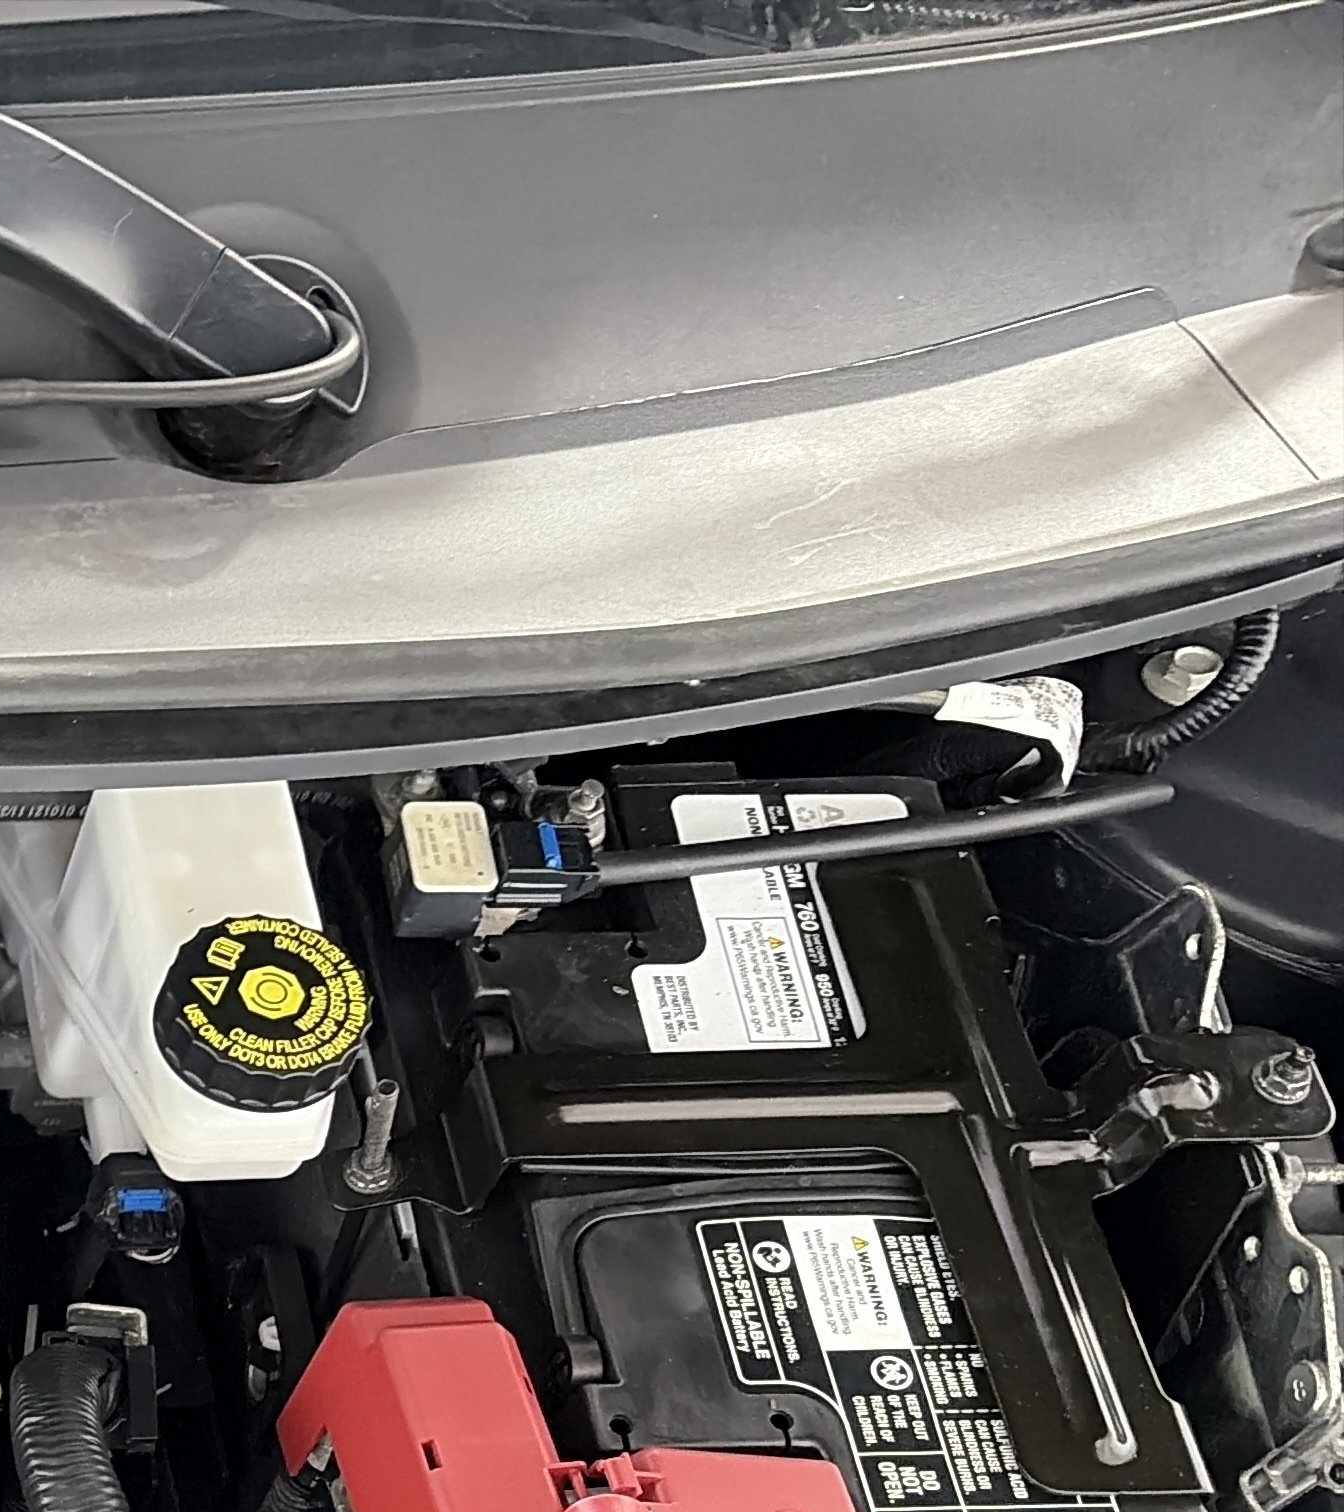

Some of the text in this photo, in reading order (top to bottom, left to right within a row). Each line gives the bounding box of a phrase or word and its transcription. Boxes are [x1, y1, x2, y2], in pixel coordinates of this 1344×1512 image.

[793, 901, 821, 931] 760
[183, 919, 367, 1069] USE ONLY DOT3 OR DOT4 BRAKE FLUID FROM A SEALED CONTAINER
[229, 935, 347, 1053] CLEAN FILLER CAP BEFORE REMOVING
[663, 975, 677, 992] BEST
[675, 975, 700, 1031] DISTRIBUTED BY
[761, 965, 787, 1012] Reproductive
[771, 951, 806, 1022] WARNING:
[813, 973, 835, 997] 950
[293, 985, 327, 1032] WARNING
[811, 1228, 828, 1251] Wash
[882, 1235, 910, 1285] OR INJURY.
[819, 1253, 836, 1277] hands
[827, 1242, 854, 1294] Reproductive
[827, 1279, 842, 1297] after
[844, 1258, 868, 1305] Cancer and
[854, 1251, 891, 1326] WARNING:
[896, 1235, 941, 1337] CAN CAUSE BLINDNESS
[910, 1234, 953, 1324] EXPLOSIVE GASES
[710, 1249, 753, 1352] Lead Acid Battery
[719, 1241, 775, 1360] NON-SPILLABLE
[776, 1277, 799, 1309] READ
[761, 1277, 802, 1364] INSTRUCTIONS.
[922, 1360, 950, 1404] SMOKING
[938, 1360, 963, 1397] FLAMES
[954, 1360, 978, 1397] SPARKS
[849, 1395, 880, 1447] CHILDREN.
[867, 1394, 896, 1443] REACH OF
[884, 1394, 909, 1428] OF THE
[902, 1394, 930, 1440] KEEP OUT
[940, 1419, 978, 1495] SEVERE BURNS.
[956, 1419, 992, 1489] BLINDNESS OR
[972, 1419, 1003, 1473] CAN CAUSE
[988, 1418, 1029, 1498] SULFURIC ACID
[875, 1461, 907, 1503] OPEN.
[896, 1466, 924, 1496] NOT
[917, 1470, 941, 1490] DO
